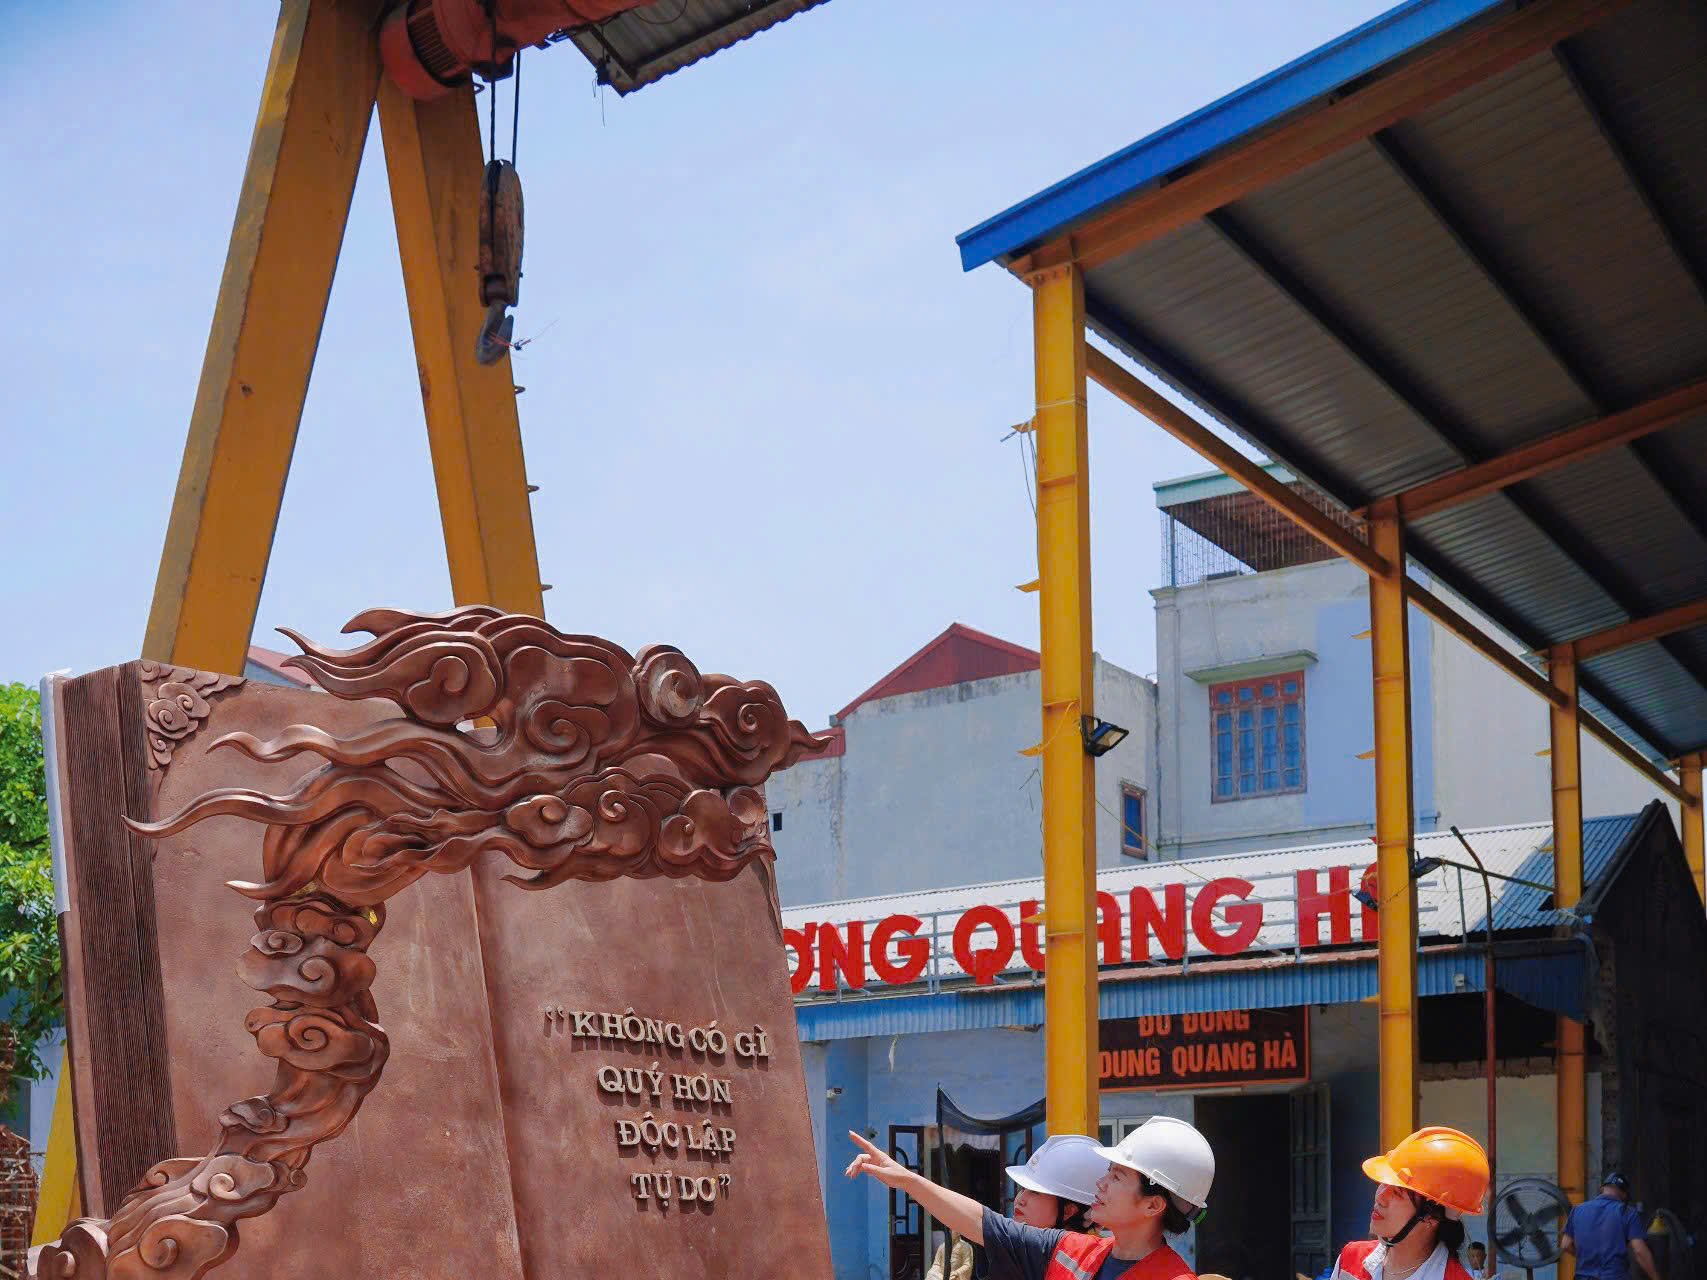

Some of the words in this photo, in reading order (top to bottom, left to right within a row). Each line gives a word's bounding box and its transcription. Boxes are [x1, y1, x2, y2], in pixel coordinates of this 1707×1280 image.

[688, 1020, 728, 1055] CÓ
[734, 1024, 769, 1057] GÌ
[1171, 1041, 1256, 1077] QUANG
[1263, 1031, 1297, 1069] HÀ
[598, 1061, 664, 1096] QUÝ
[672, 1072, 734, 1104] HƠN
[616, 1111, 681, 1153] ĐỘC
[684, 1119, 738, 1157] LẬP
[630, 1170, 673, 1207] TỰ
